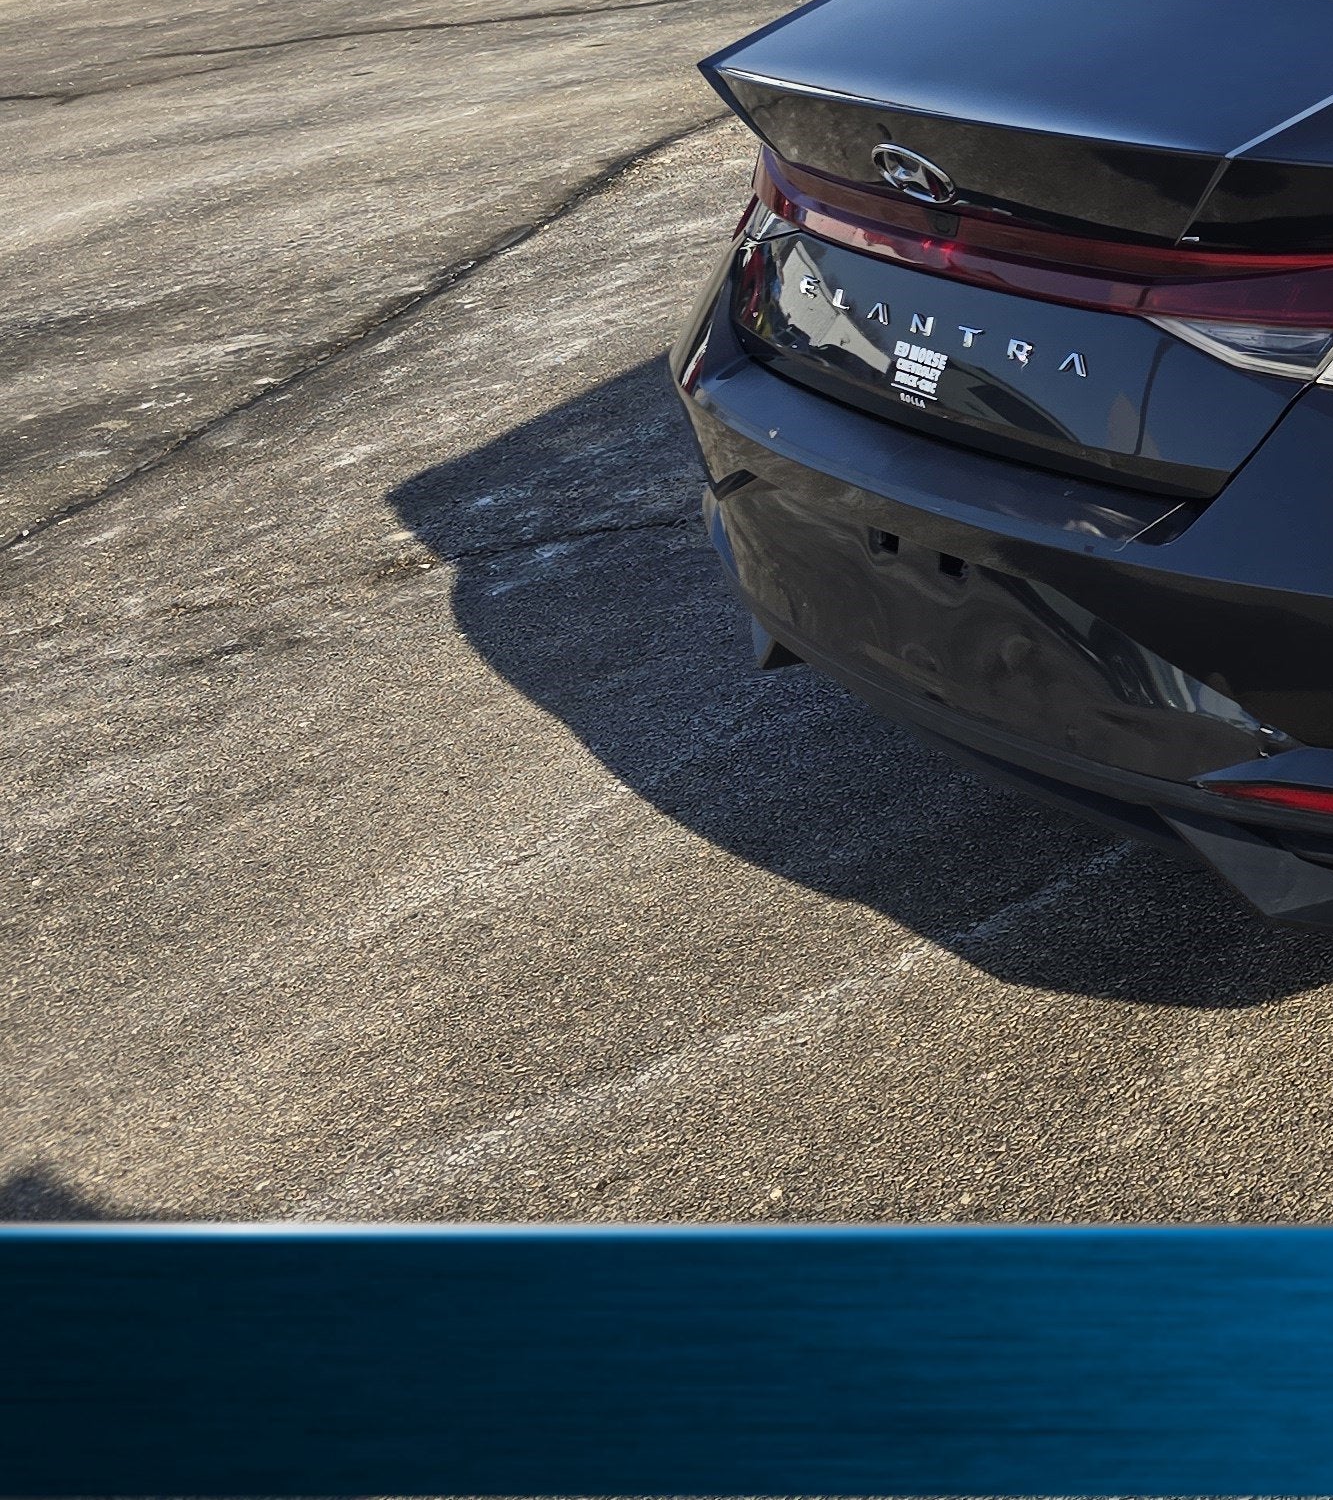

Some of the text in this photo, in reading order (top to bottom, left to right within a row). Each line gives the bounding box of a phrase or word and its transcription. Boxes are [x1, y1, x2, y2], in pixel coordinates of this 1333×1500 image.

[799, 274, 1088, 378] ELANTRA
[893, 340, 948, 371] ED MORSE
